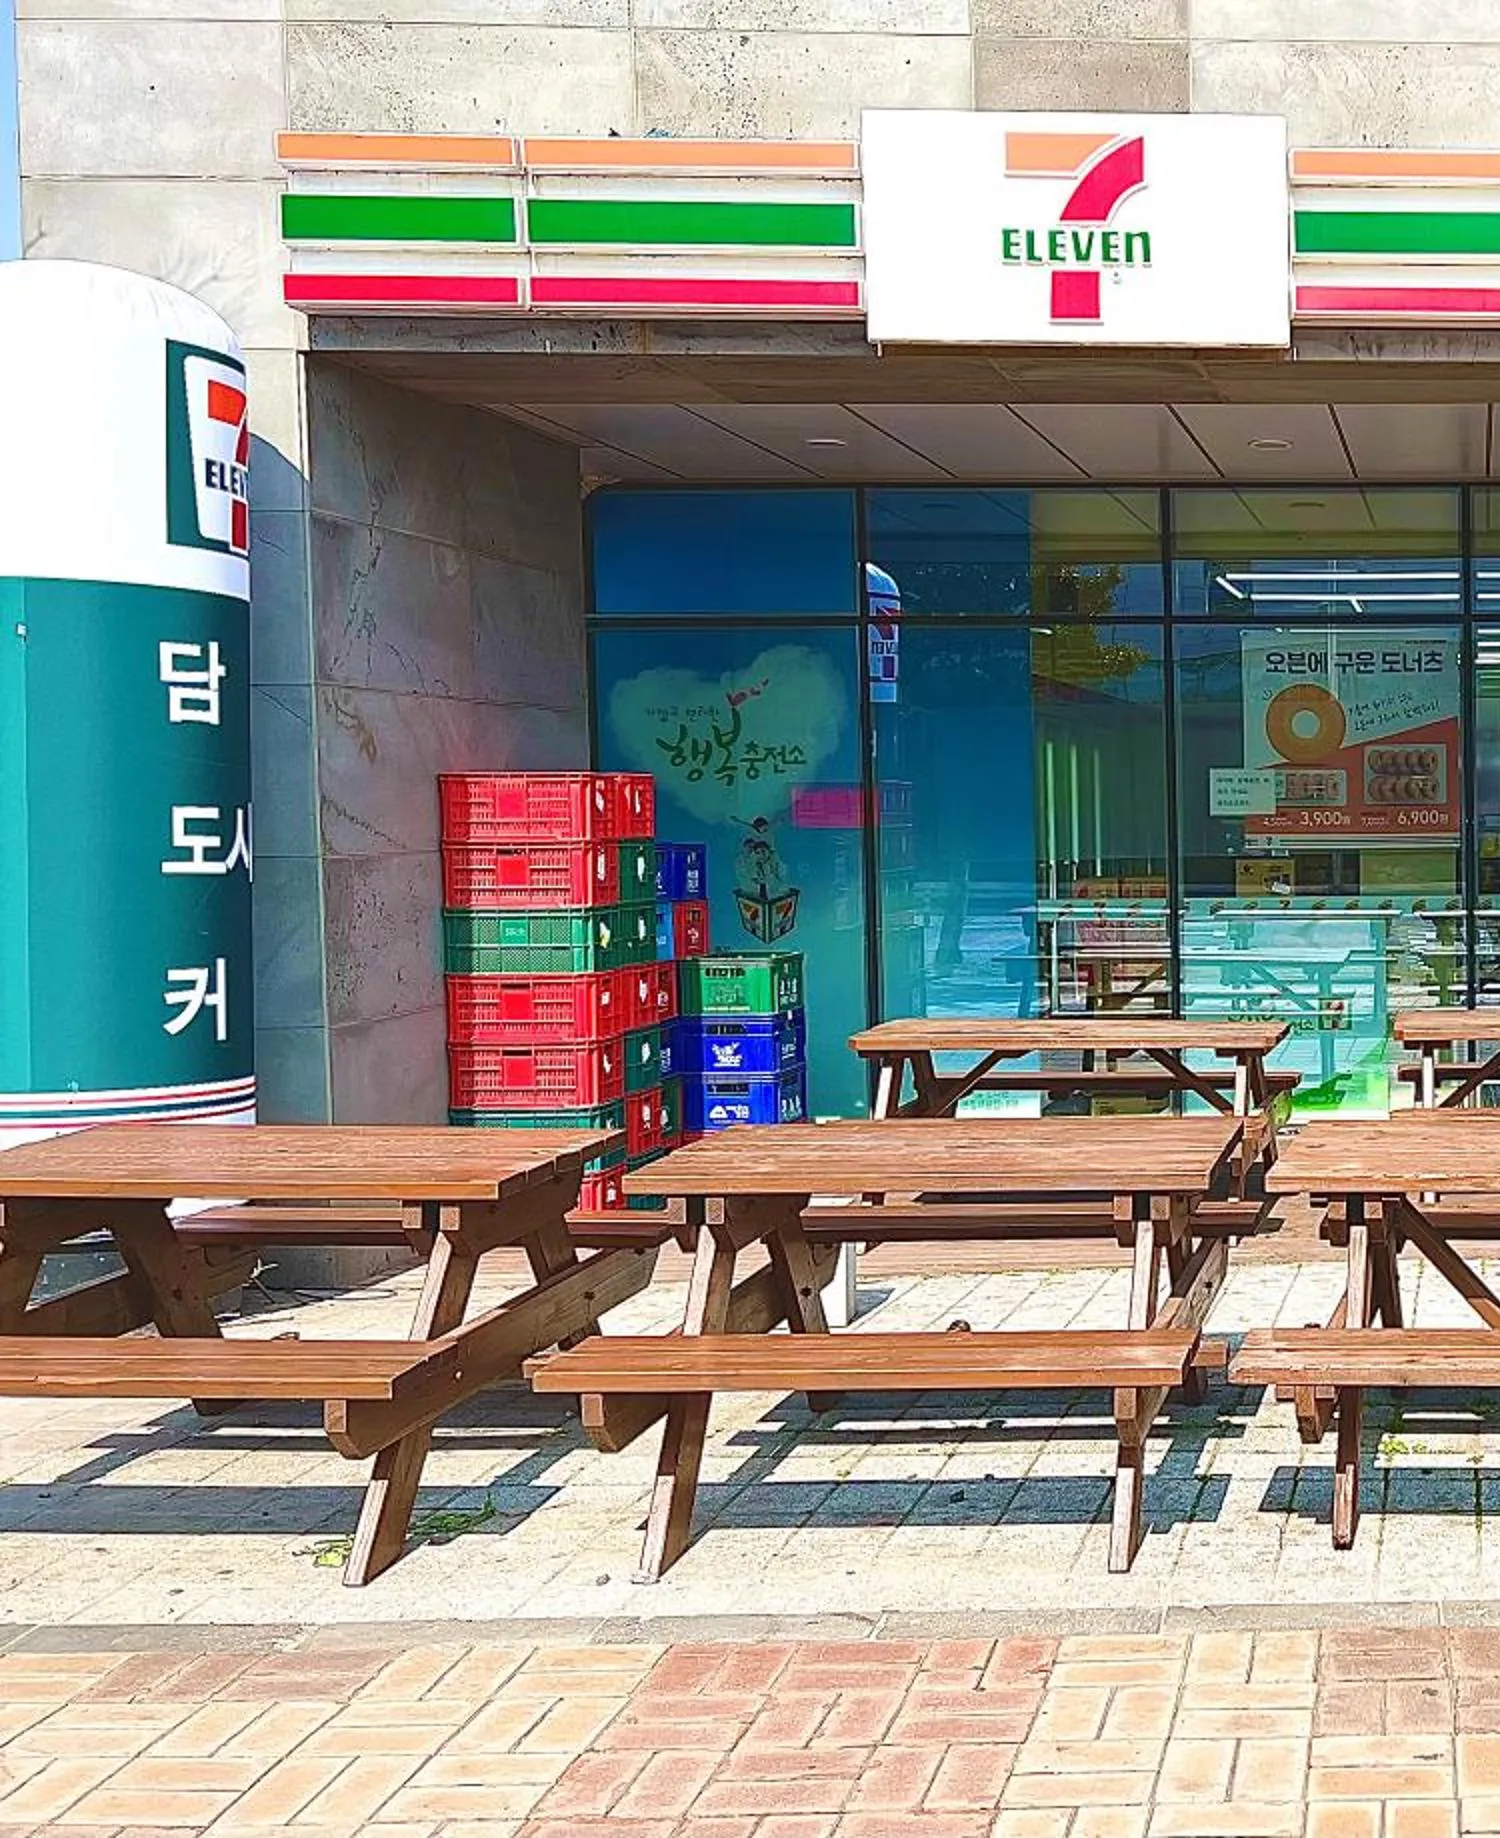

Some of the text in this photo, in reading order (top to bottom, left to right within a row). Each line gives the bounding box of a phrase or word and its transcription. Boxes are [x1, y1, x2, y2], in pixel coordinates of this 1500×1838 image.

[1266, 651, 1443, 674] 오븐에 구운 도너츠
